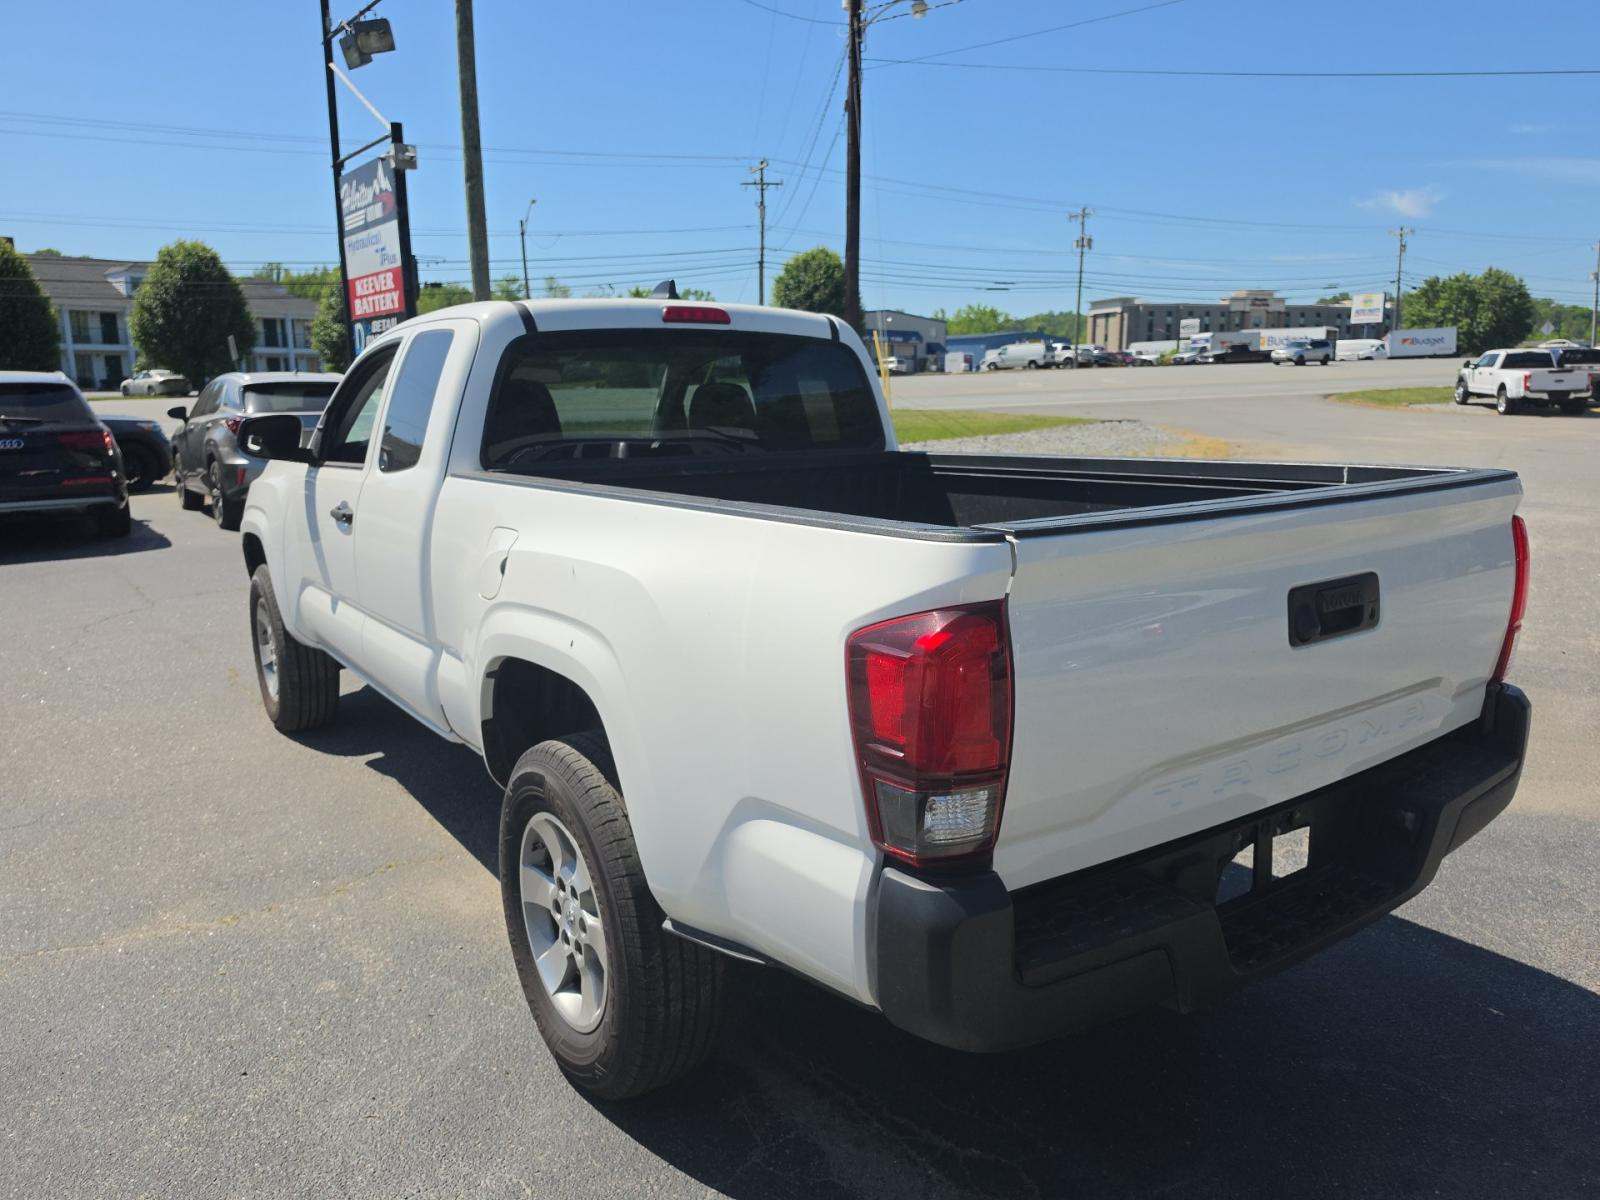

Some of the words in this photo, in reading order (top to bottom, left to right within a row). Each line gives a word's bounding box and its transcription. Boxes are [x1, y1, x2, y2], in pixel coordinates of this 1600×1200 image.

[355, 272, 395, 297] KEEVER
[354, 290, 400, 316] BATTERY
[1152, 699, 1426, 807] TACOMA
